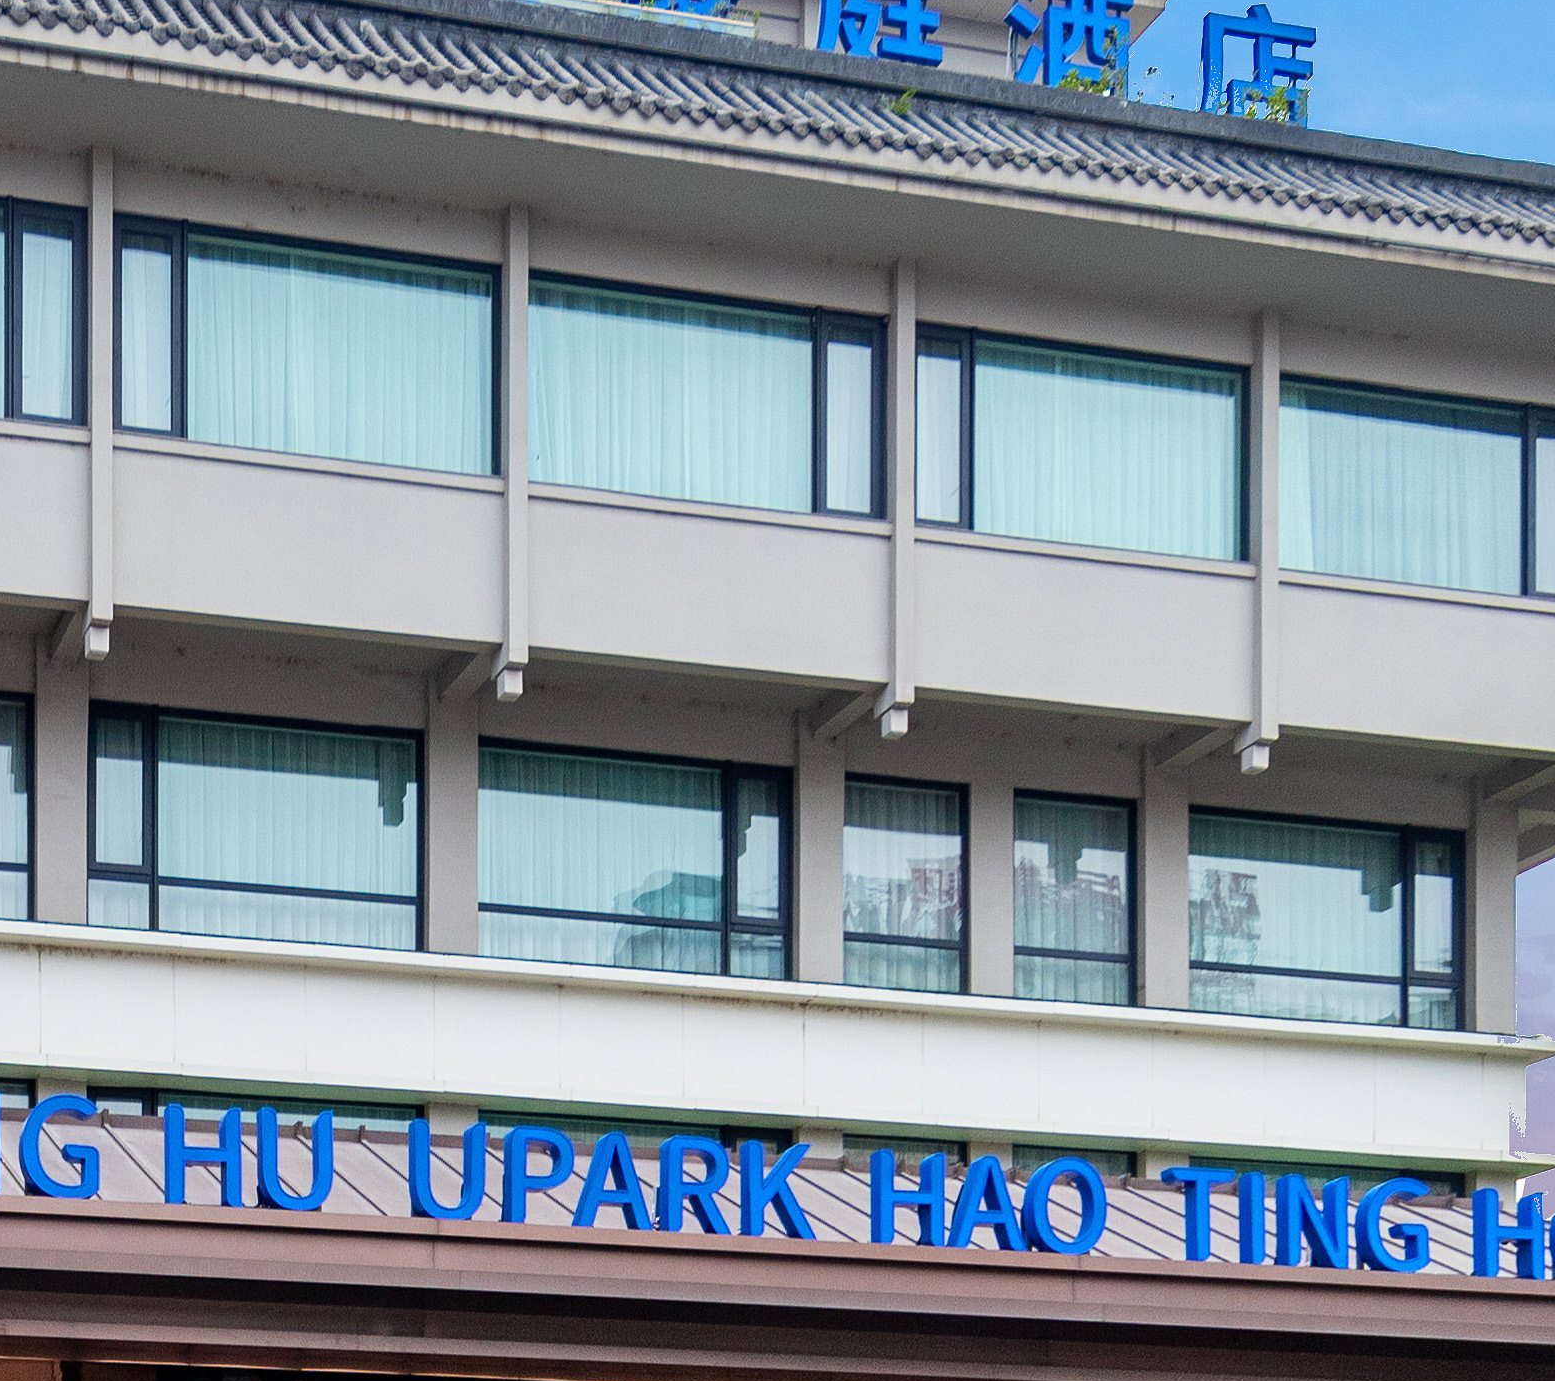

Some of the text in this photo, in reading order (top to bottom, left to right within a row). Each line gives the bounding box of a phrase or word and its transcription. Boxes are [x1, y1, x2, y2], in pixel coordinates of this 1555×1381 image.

[162, 1102, 335, 1211] HU
[407, 1117, 817, 1240] UPARK
[869, 1148, 1108, 1255] HAO
[1160, 1166, 1432, 1273] TING
